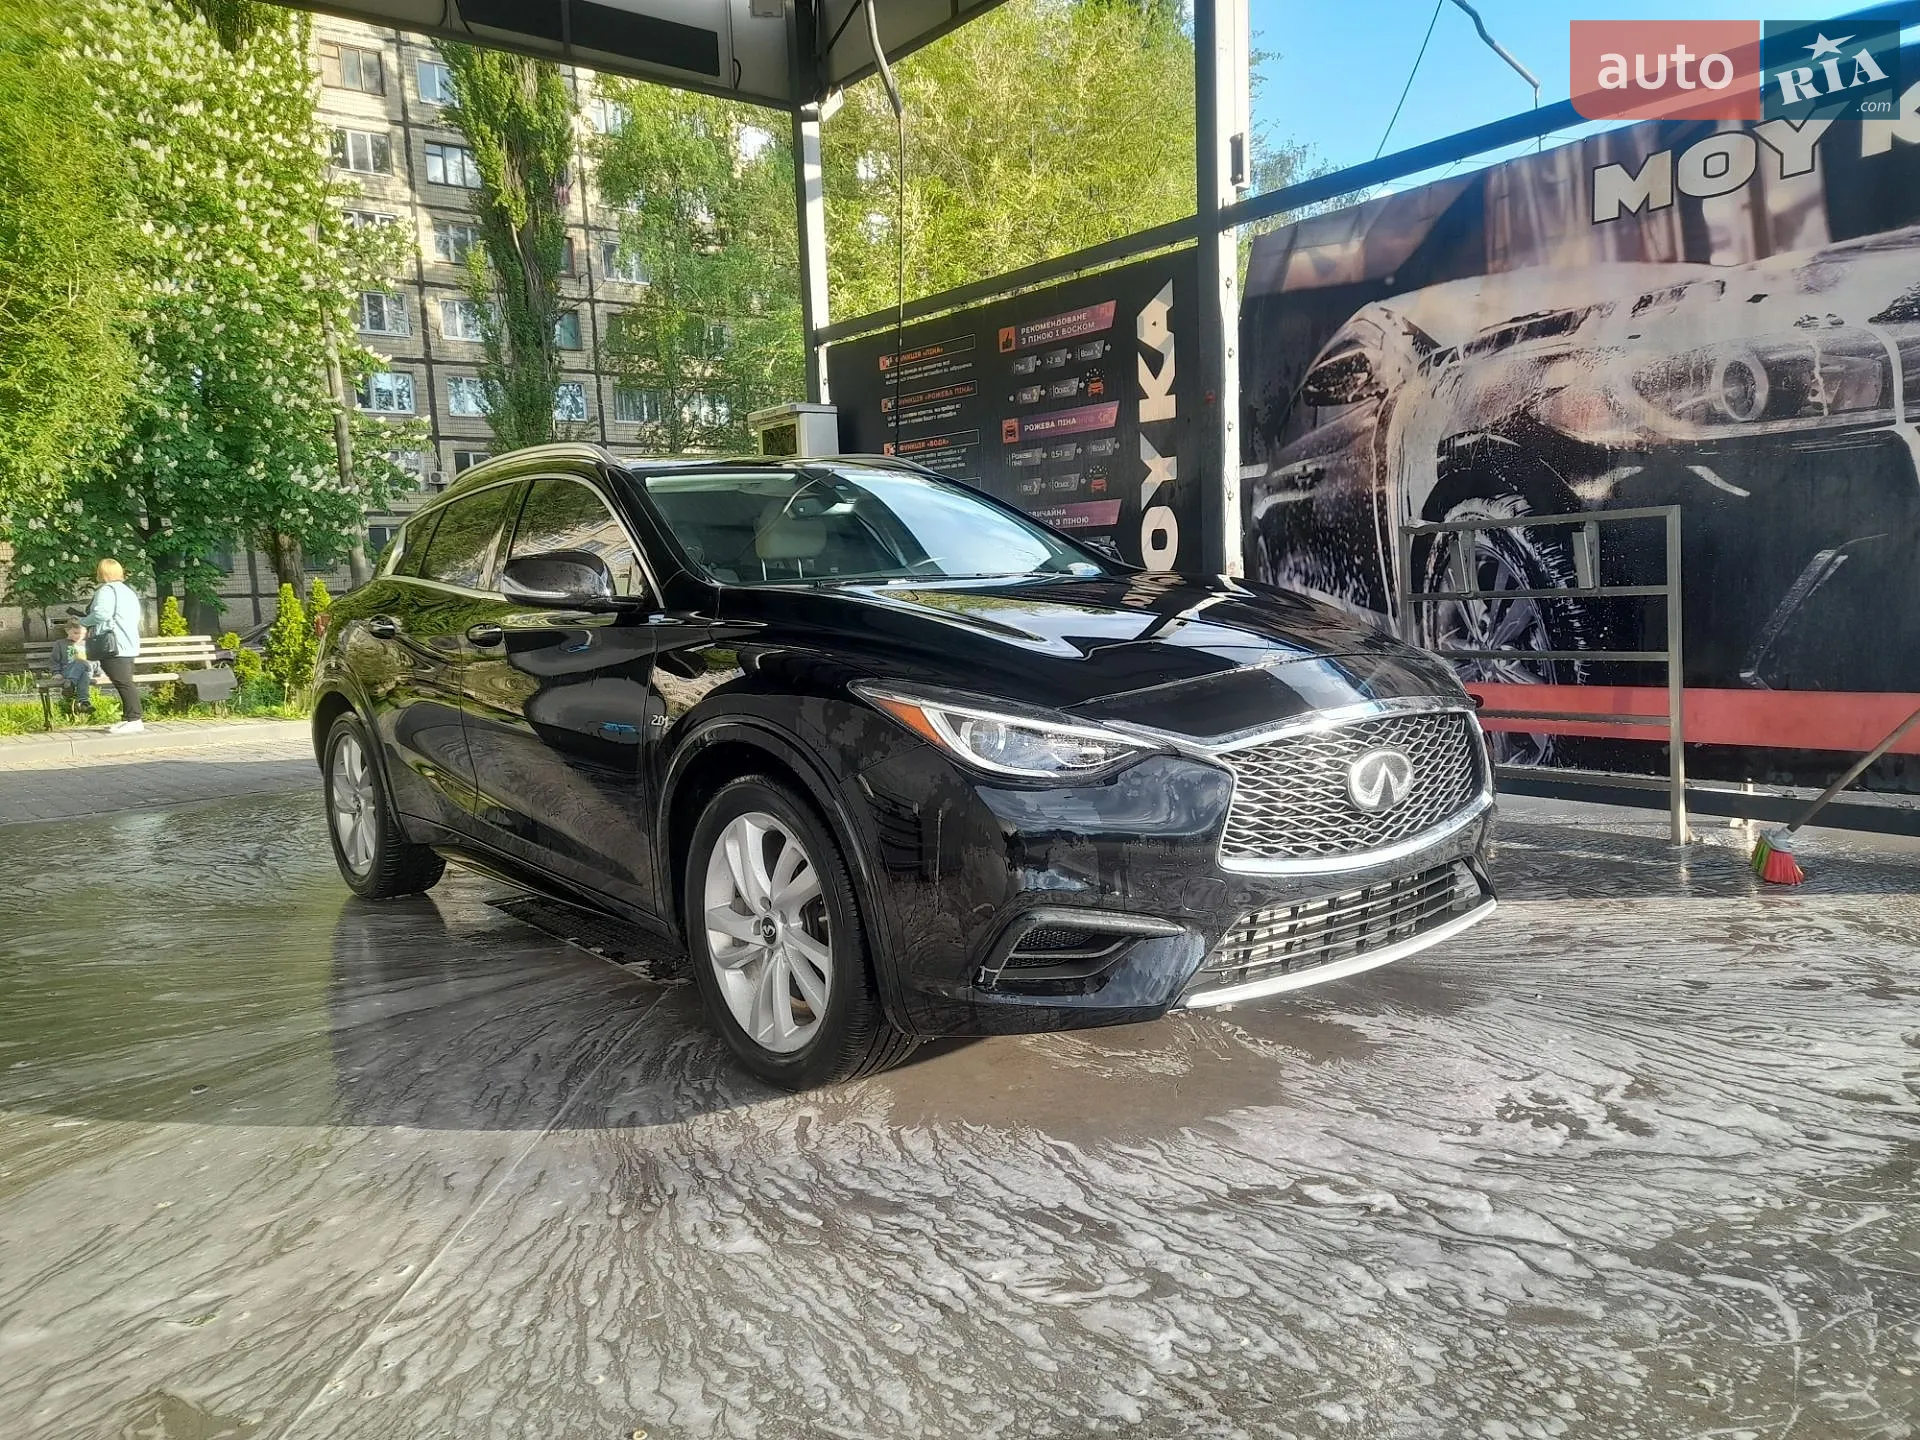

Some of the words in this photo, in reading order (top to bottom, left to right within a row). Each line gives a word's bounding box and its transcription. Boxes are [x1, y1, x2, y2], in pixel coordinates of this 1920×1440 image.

[1020, 312, 1088, 335] РЕКОМЕНДОВАНЕ
[1028, 331, 1054, 344] ПІНОЮ
[1061, 321, 1095, 335] ВОСКОМ
[1024, 420, 1056, 432] РОЖЕВА
[1057, 417, 1077, 427] ПІНА
[1136, 278, 1179, 572] OYKA
[1062, 516, 1089, 525] ПІНОЮ
